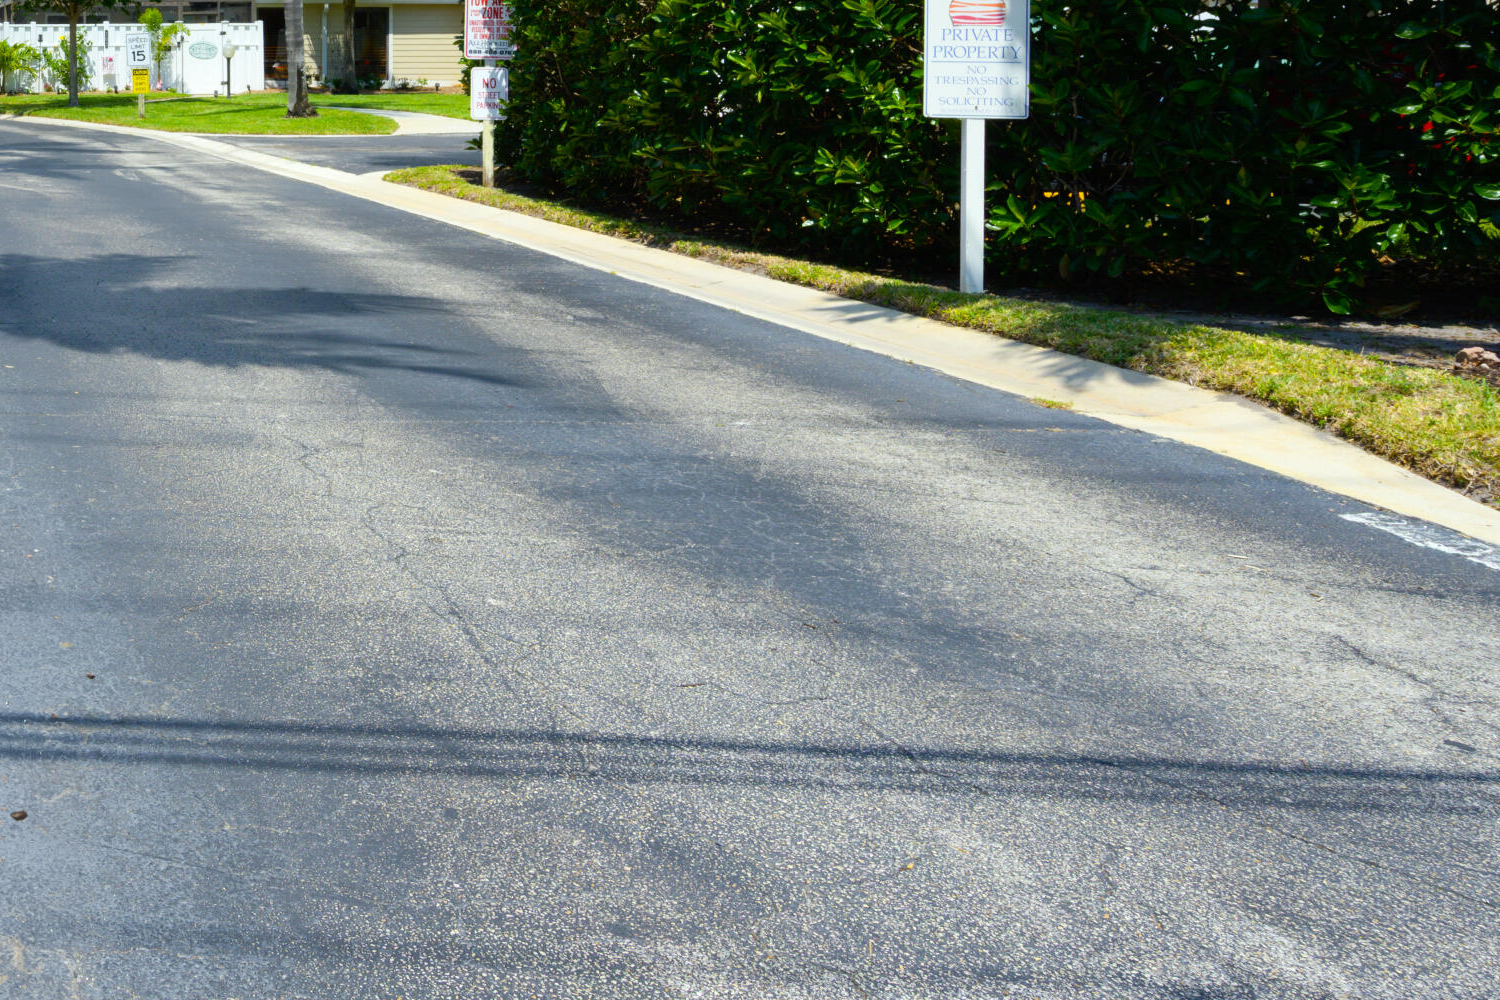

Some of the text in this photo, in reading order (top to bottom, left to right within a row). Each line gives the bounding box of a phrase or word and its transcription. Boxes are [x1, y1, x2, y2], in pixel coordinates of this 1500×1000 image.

[482, 6, 504, 19] ZONE
[941, 28, 1014, 41] PRIVATE
[131, 50, 146, 62] 15
[932, 45, 1022, 59] PROPERTY
[966, 65, 987, 75] NO
[482, 78, 497, 89] NO
[935, 76, 1019, 85] TRESPASSING
[966, 87, 987, 96] NO
[938, 97, 1014, 107] SOLICITING
